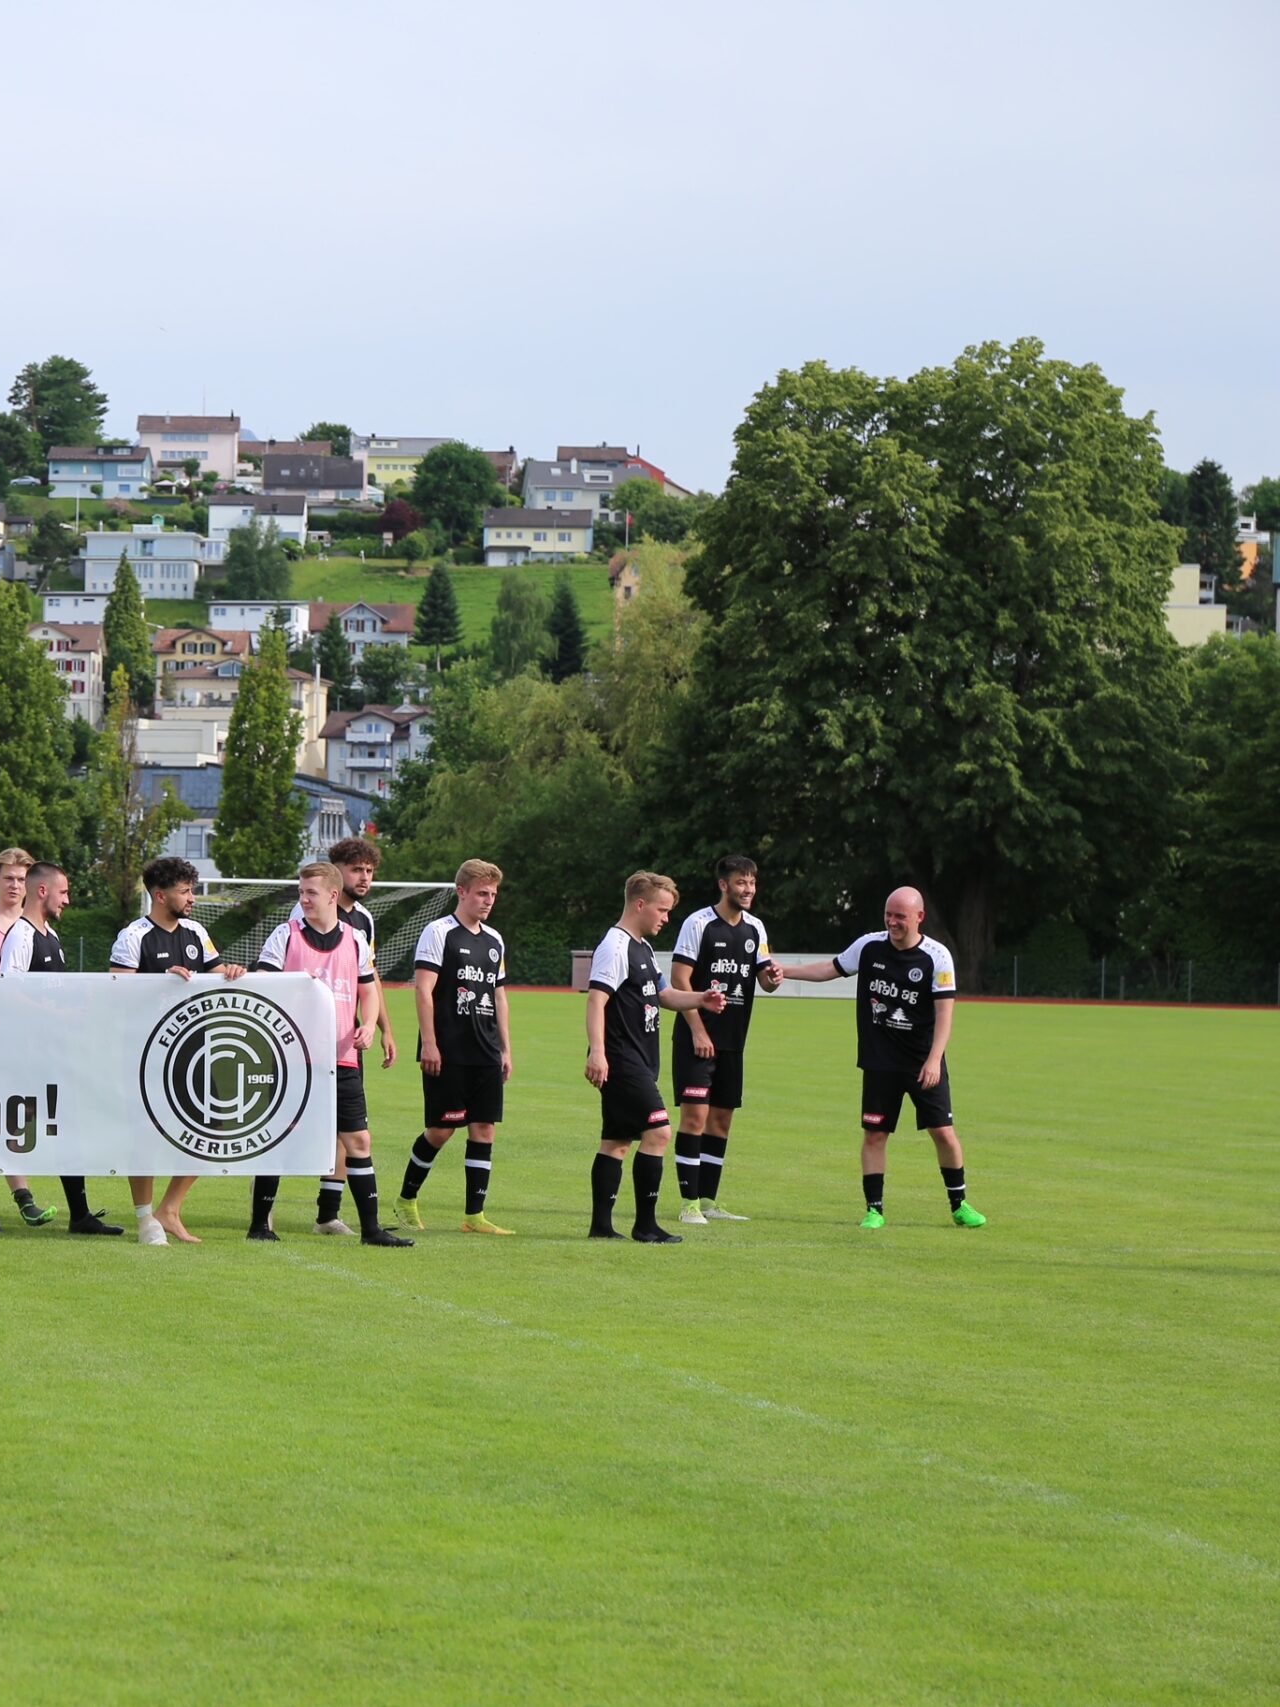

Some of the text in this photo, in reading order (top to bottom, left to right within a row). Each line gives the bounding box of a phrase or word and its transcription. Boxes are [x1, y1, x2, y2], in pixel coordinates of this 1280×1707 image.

[901, 989, 919, 1005] ag
[158, 995, 296, 1049] FUSSBALLCLUB
[246, 1074, 275, 1084] 1906
[178, 1128, 272, 1156] HERISAU
